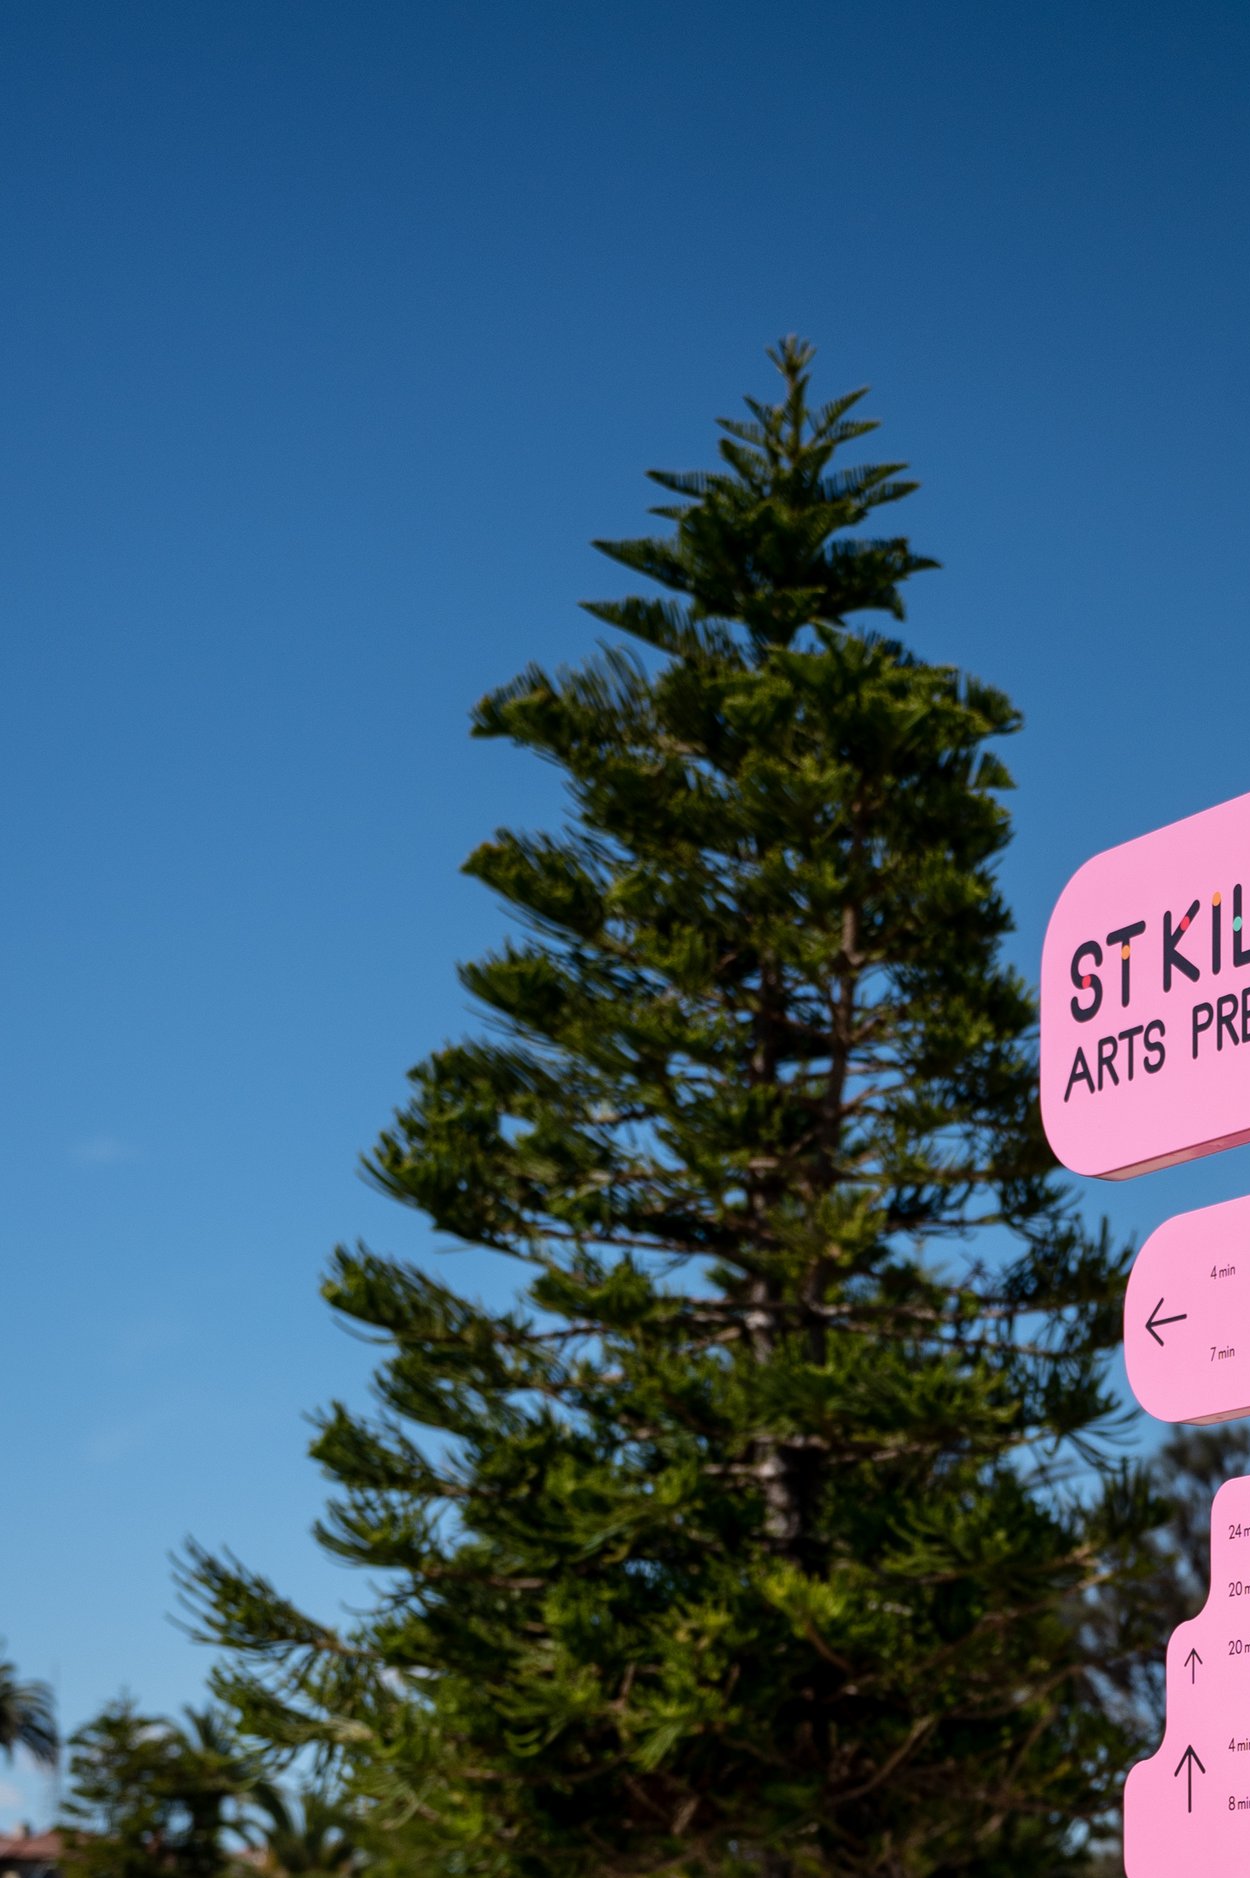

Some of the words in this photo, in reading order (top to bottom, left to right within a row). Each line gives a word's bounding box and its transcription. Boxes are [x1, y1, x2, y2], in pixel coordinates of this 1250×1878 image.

[1070, 920, 1146, 1023] ST
[1063, 1019, 1166, 1103] ARTS
[1210, 1265, 1217, 1280] 4
[1218, 1264, 1236, 1278] min
[1210, 1347, 1216, 1362] 7
[1218, 1346, 1235, 1360] min
[1228, 1525, 1242, 1540] 24
[1228, 1582, 1243, 1597] 20
[1228, 1640, 1242, 1656] 20
[1228, 1739, 1236, 1752] 4
[1228, 1797, 1236, 1811] 8
